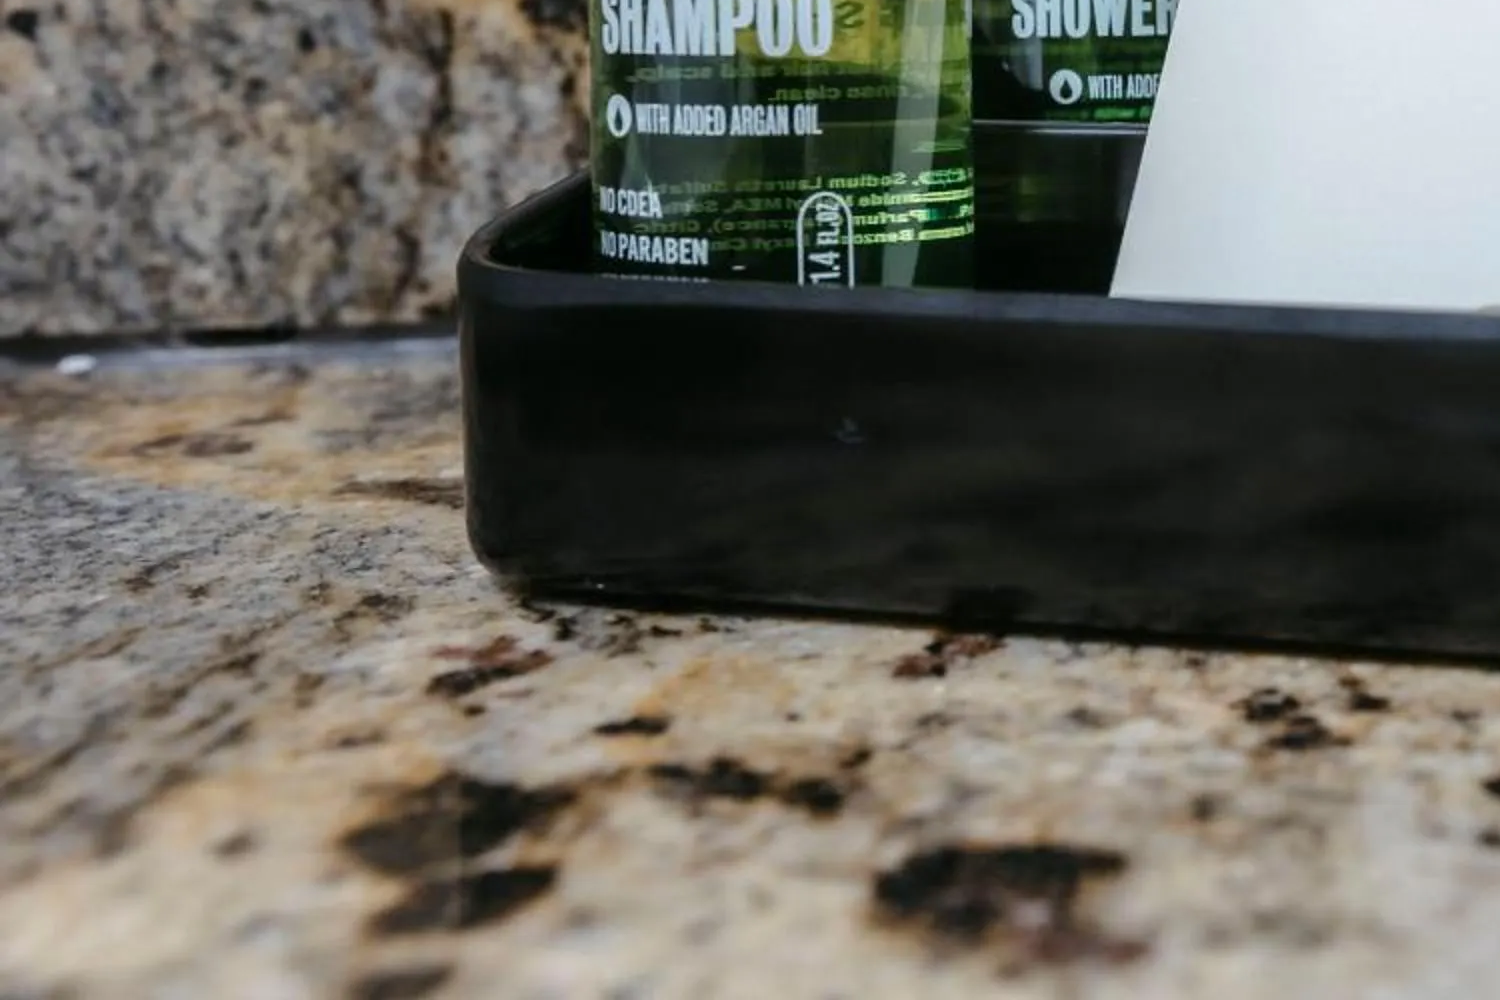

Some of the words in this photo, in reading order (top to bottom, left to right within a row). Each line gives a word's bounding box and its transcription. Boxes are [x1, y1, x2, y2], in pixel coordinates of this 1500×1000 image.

[1087, 74, 1122, 99] WITH
[1126, 74, 1162, 99] ADDE
[635, 103, 669, 135] WITH
[673, 104, 727, 137] ADDED
[729, 104, 790, 137] ARGAN
[793, 103, 824, 137] OIL
[617, 188, 664, 219] CDEA
[618, 232, 710, 267] PARABEN
